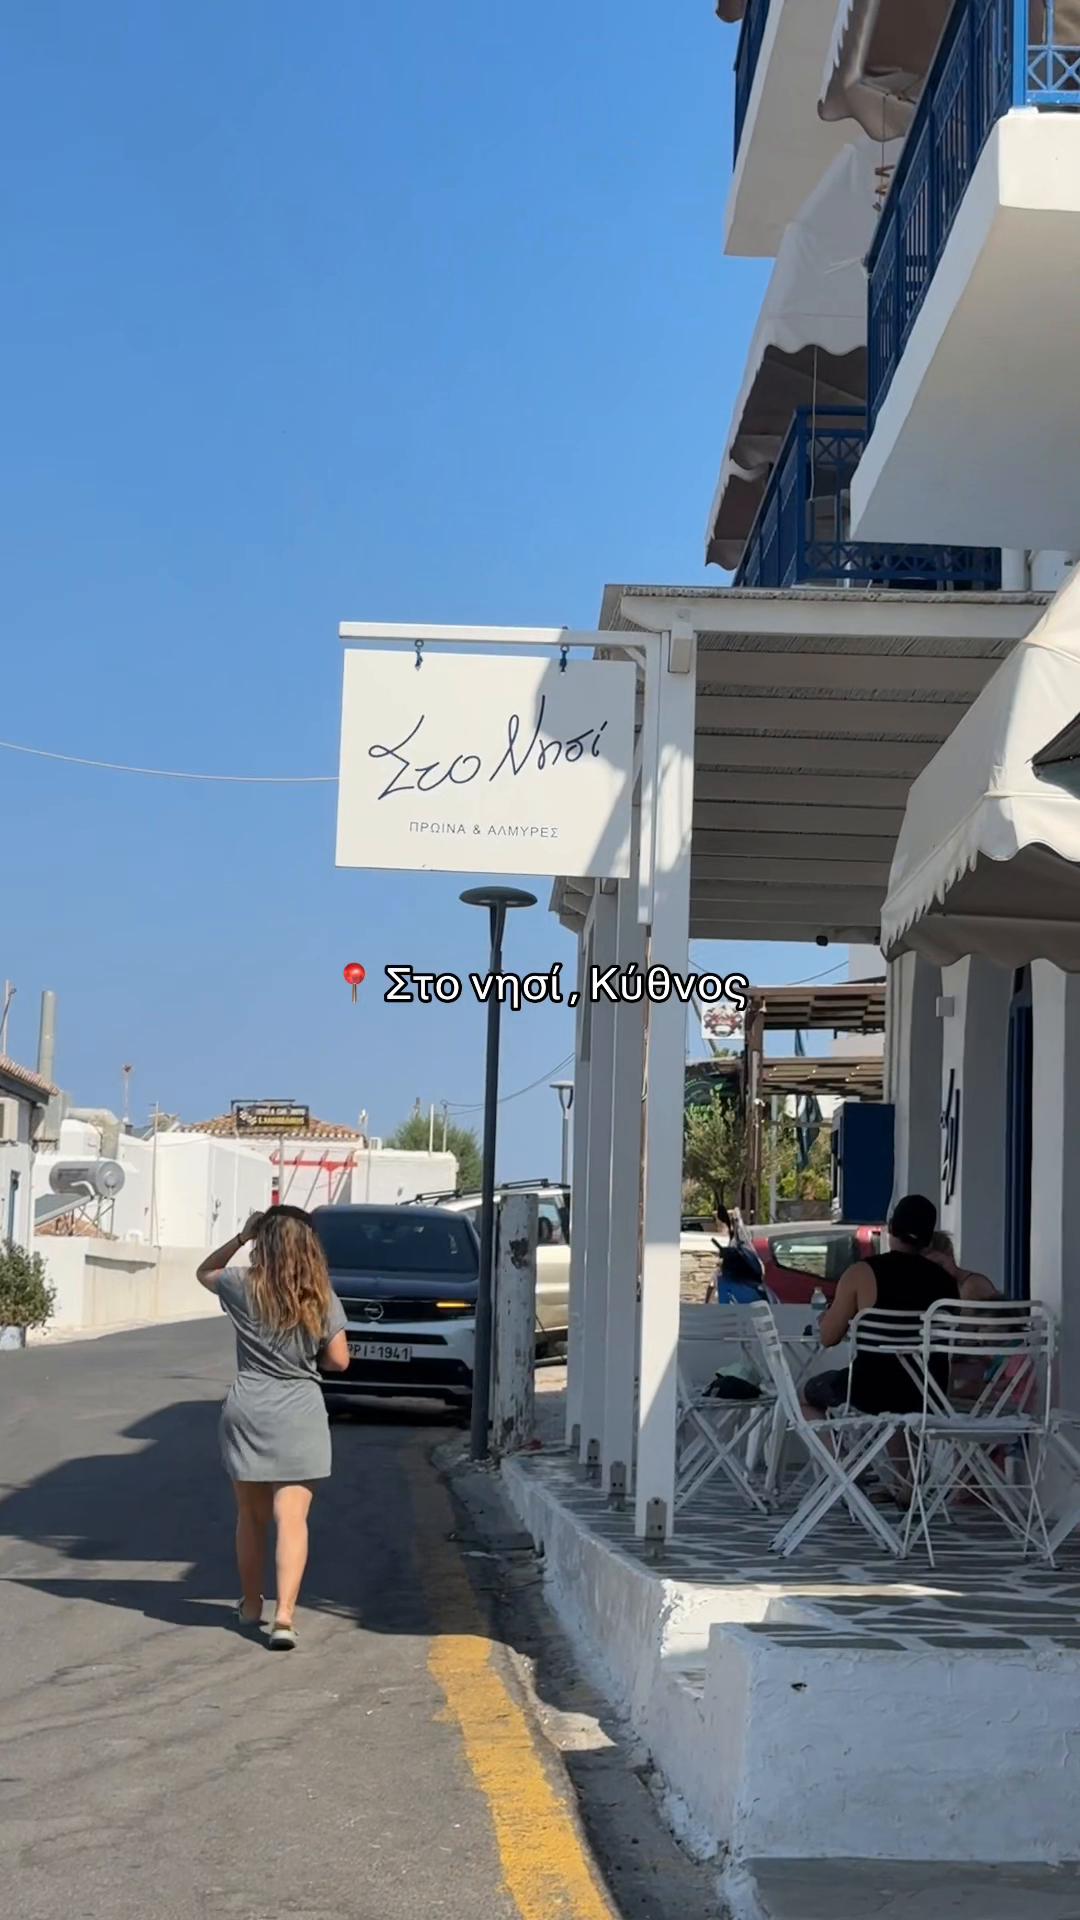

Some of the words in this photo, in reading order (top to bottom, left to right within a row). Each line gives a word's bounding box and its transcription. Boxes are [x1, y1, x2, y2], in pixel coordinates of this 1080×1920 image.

[368, 714, 481, 800] Στο
[409, 821, 466, 834] ΠΡΩΙΝΑ
[472, 824, 481, 835] &
[487, 824, 559, 838] ΑΛΜΥΡΕΣ
